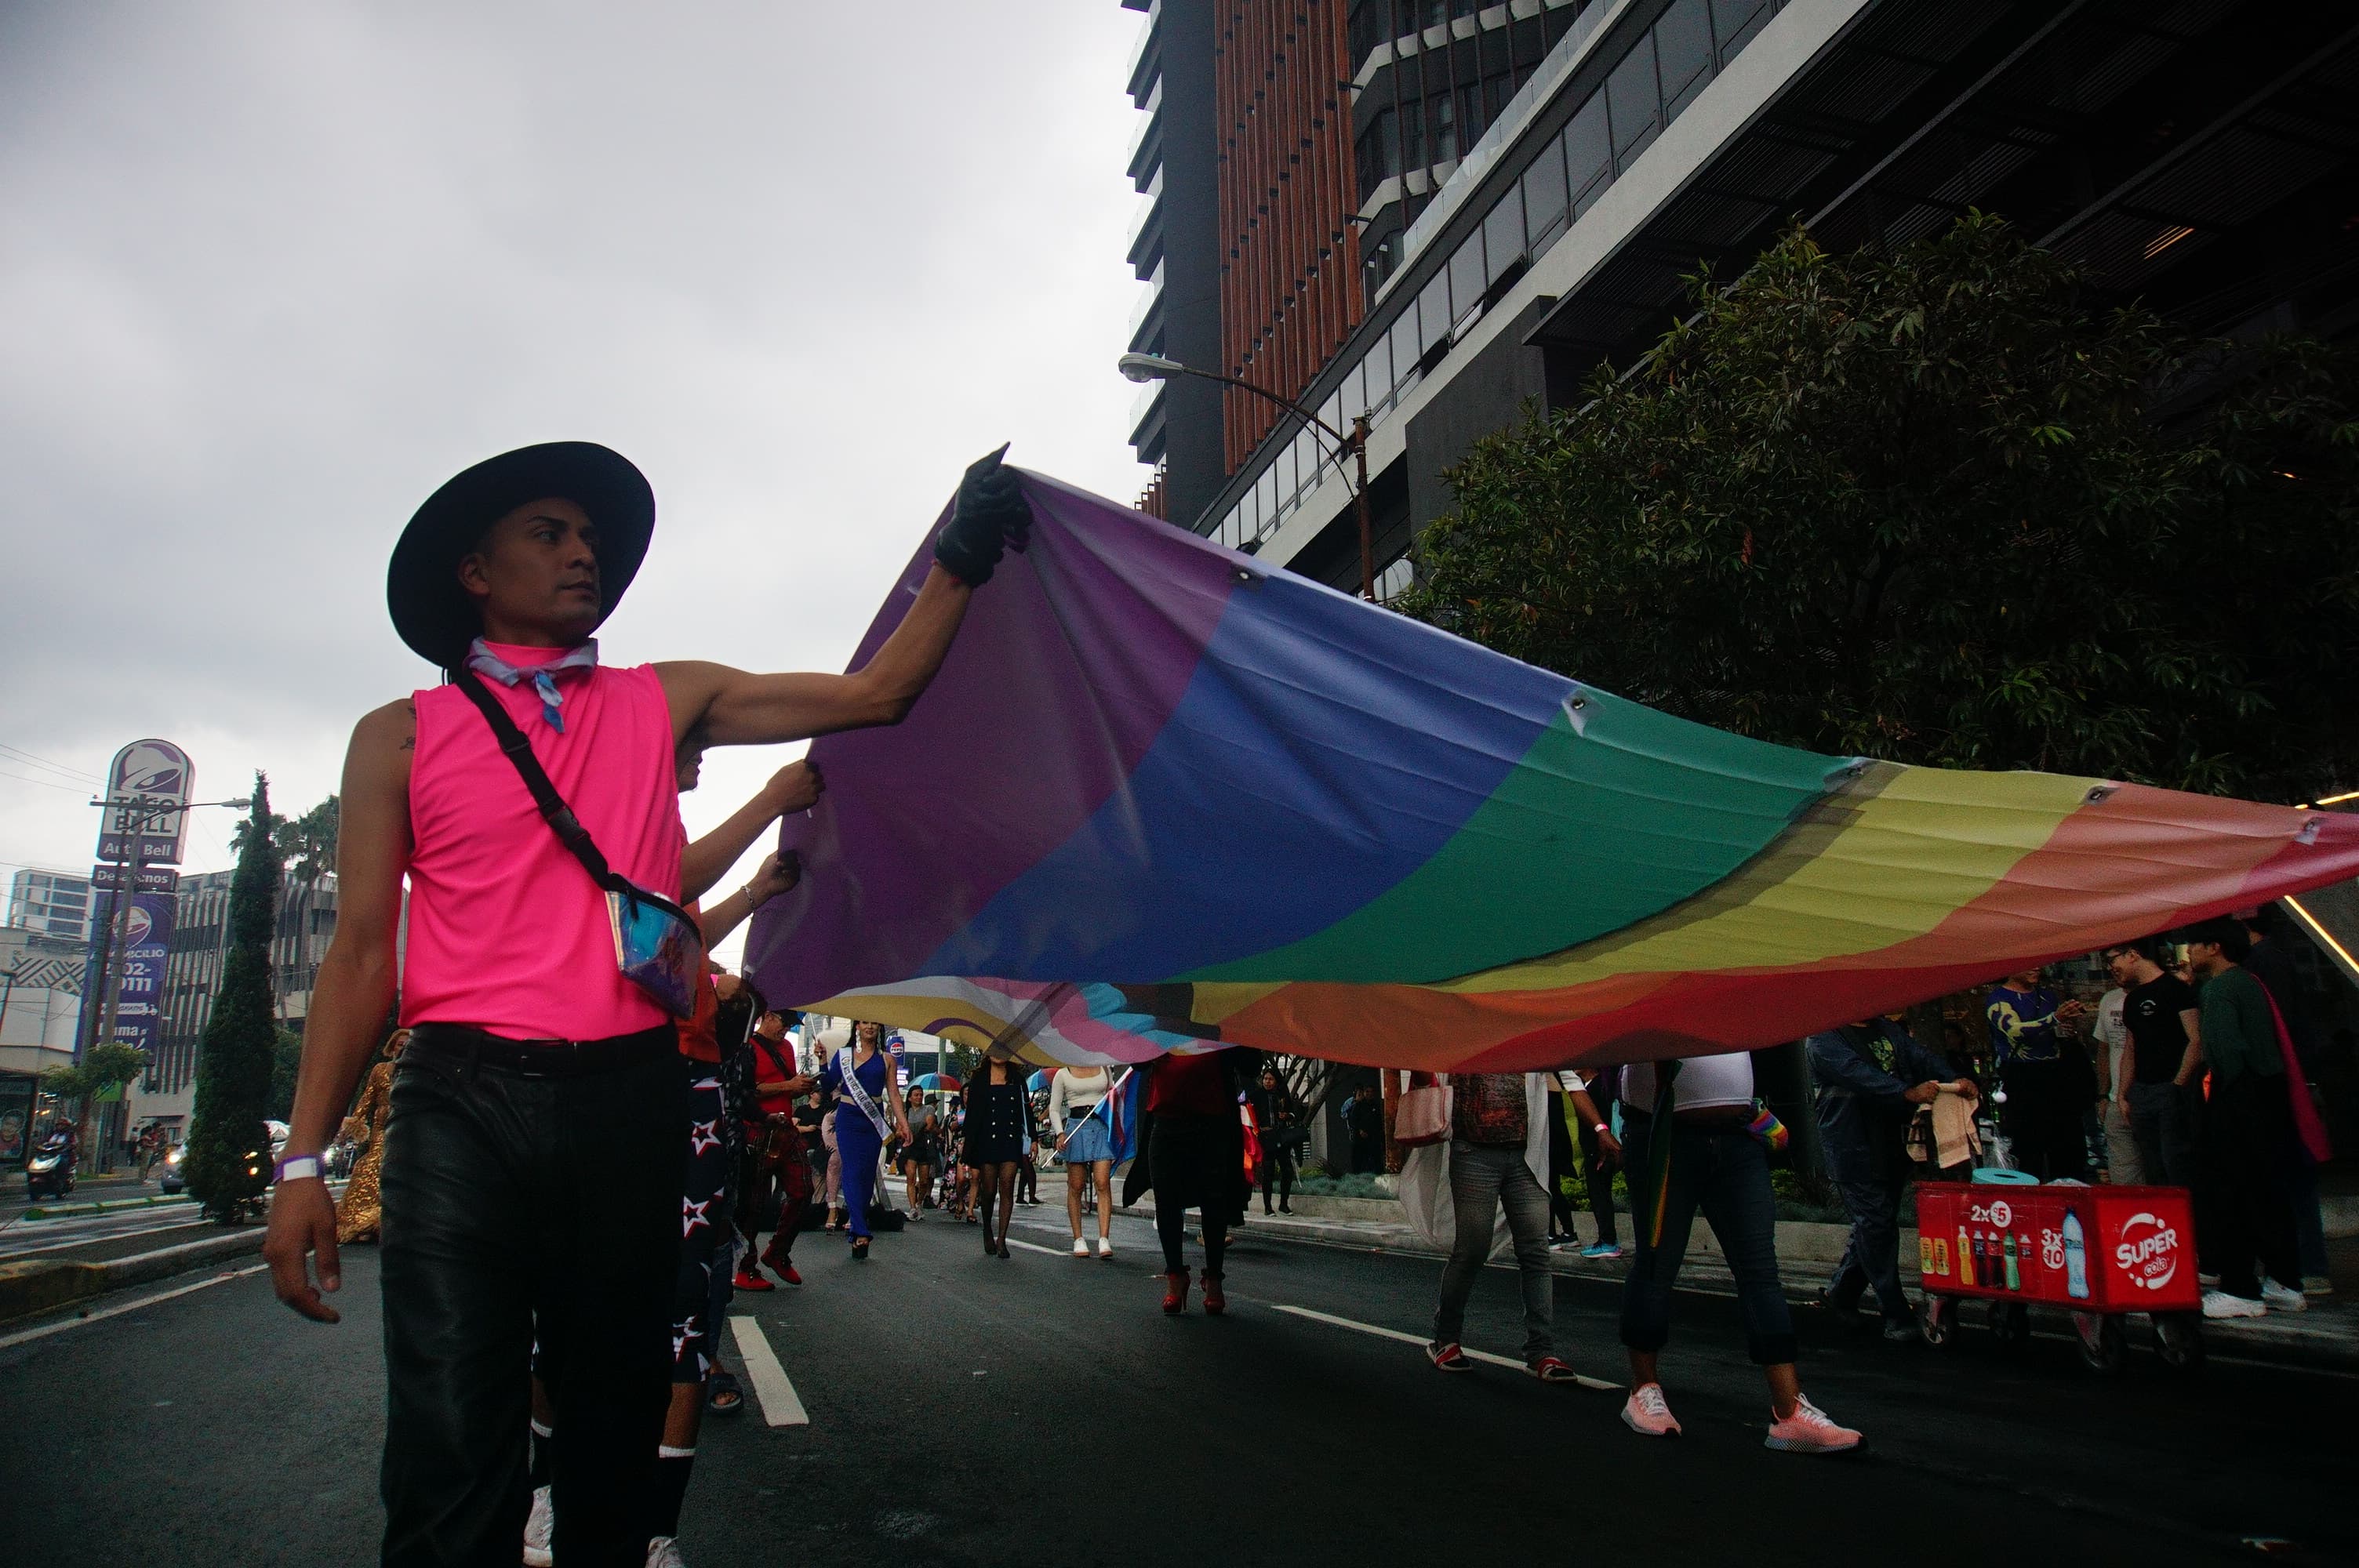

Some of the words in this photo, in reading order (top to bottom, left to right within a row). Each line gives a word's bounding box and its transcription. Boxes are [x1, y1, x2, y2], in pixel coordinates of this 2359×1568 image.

[144, 844, 172, 856] Bell
[1971, 1205, 1990, 1221] 2x
[2041, 1229, 2062, 1247] 3x
[2116, 1229, 2178, 1269] SUPER
[2144, 1257, 2168, 1276] cola
